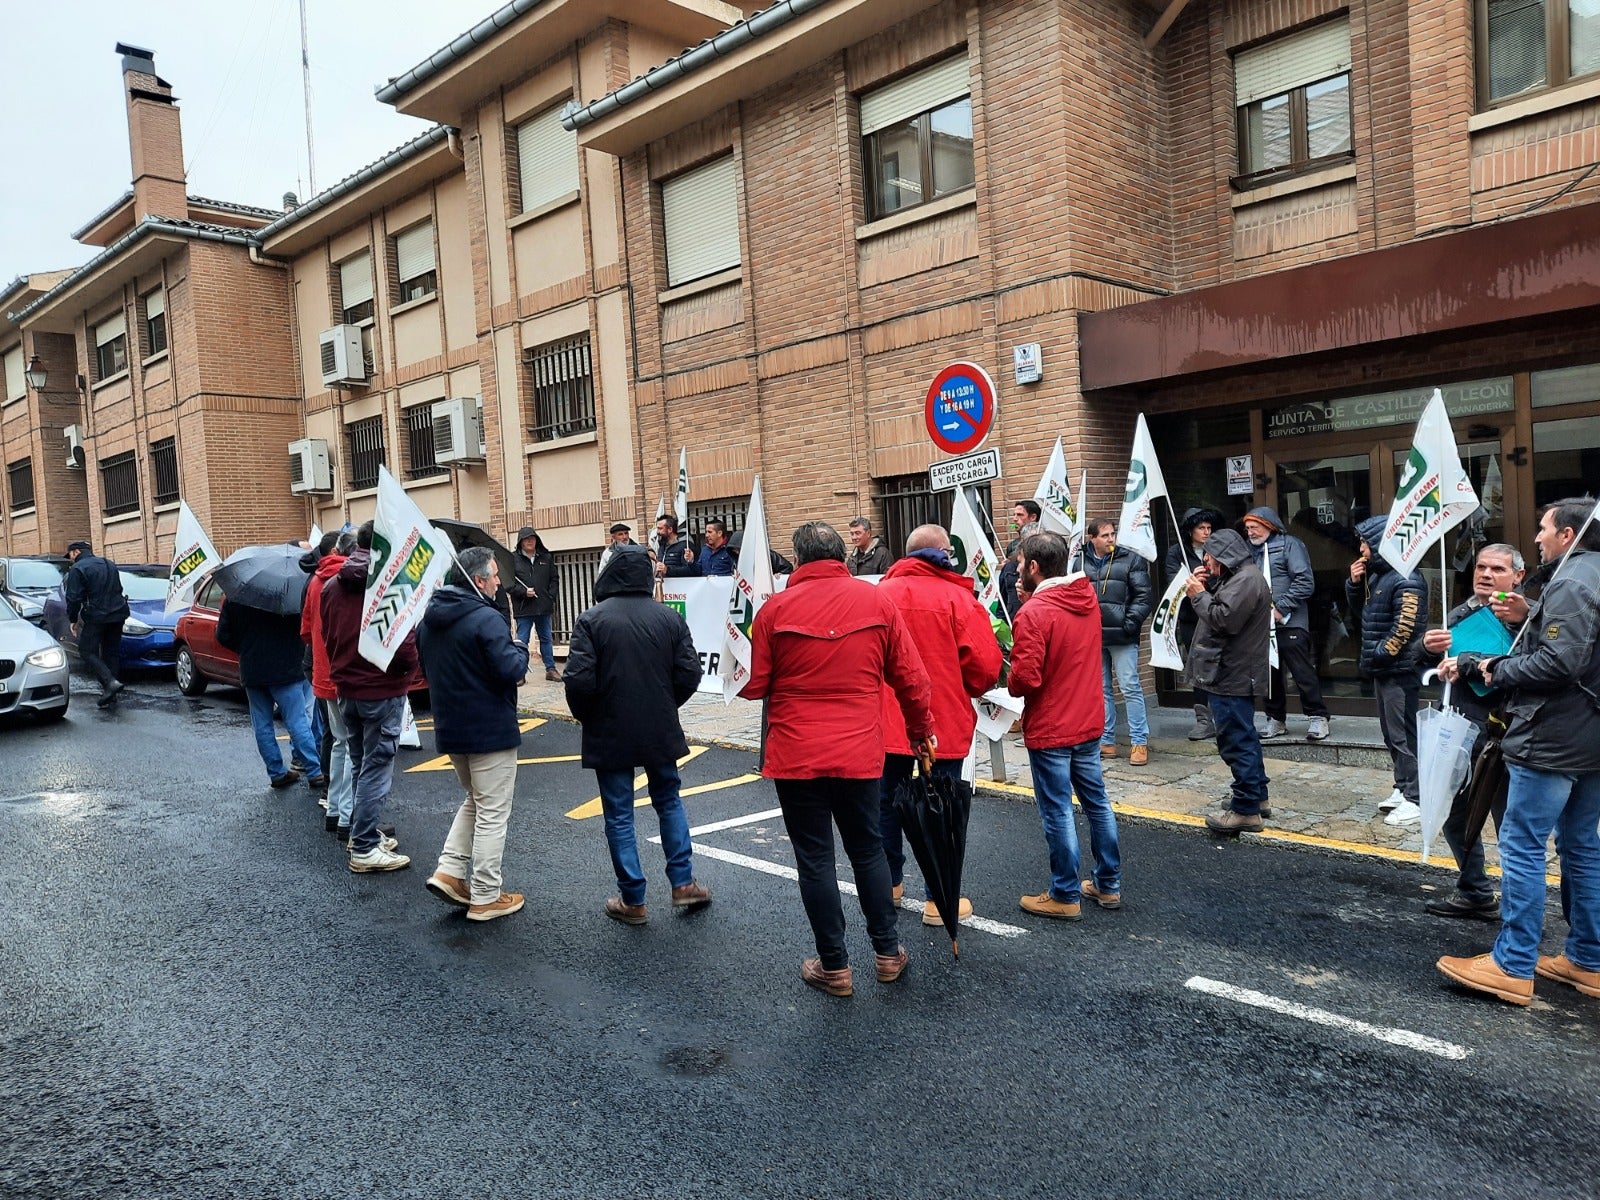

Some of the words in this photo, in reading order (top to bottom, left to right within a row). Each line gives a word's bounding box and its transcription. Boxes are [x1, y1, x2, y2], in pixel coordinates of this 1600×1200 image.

[940, 390, 947, 402] DE
[951, 388, 956, 399] A
[956, 386, 969, 397] 13:30
[969, 384, 974, 394] H
[940, 405, 944, 415] Y
[944, 403, 952, 414] DE
[952, 402, 958, 412] 16
[958, 401, 962, 411] A
[963, 400, 970, 410] 19
[969, 398, 974, 409] H
[1268, 410, 1316, 427] JUNTA
[1324, 406, 1345, 419] DE
[1354, 394, 1429, 415] CASTILLA
[1268, 426, 1306, 438] SERVICIO
[1308, 419, 1360, 432] TERRITORIAL
[1362, 418, 1375, 426] DE
[932, 462, 964, 477] EXCEPTO
[967, 456, 992, 468] CARGA
[939, 477, 944, 486] Y
[946, 467, 988, 484] DESCARGA
[1404, 502, 1414, 514] DE
[1413, 473, 1440, 502] CAMP
[1401, 535, 1422, 562] Castilla
[178, 552, 204, 574] UCCL
[405, 544, 432, 582] UCCL
[361, 598, 378, 632] UNION
[376, 582, 387, 598] DE
[384, 526, 420, 582] CAMPESINOS
[738, 578, 752, 596] DE
[727, 622, 740, 640] eón
